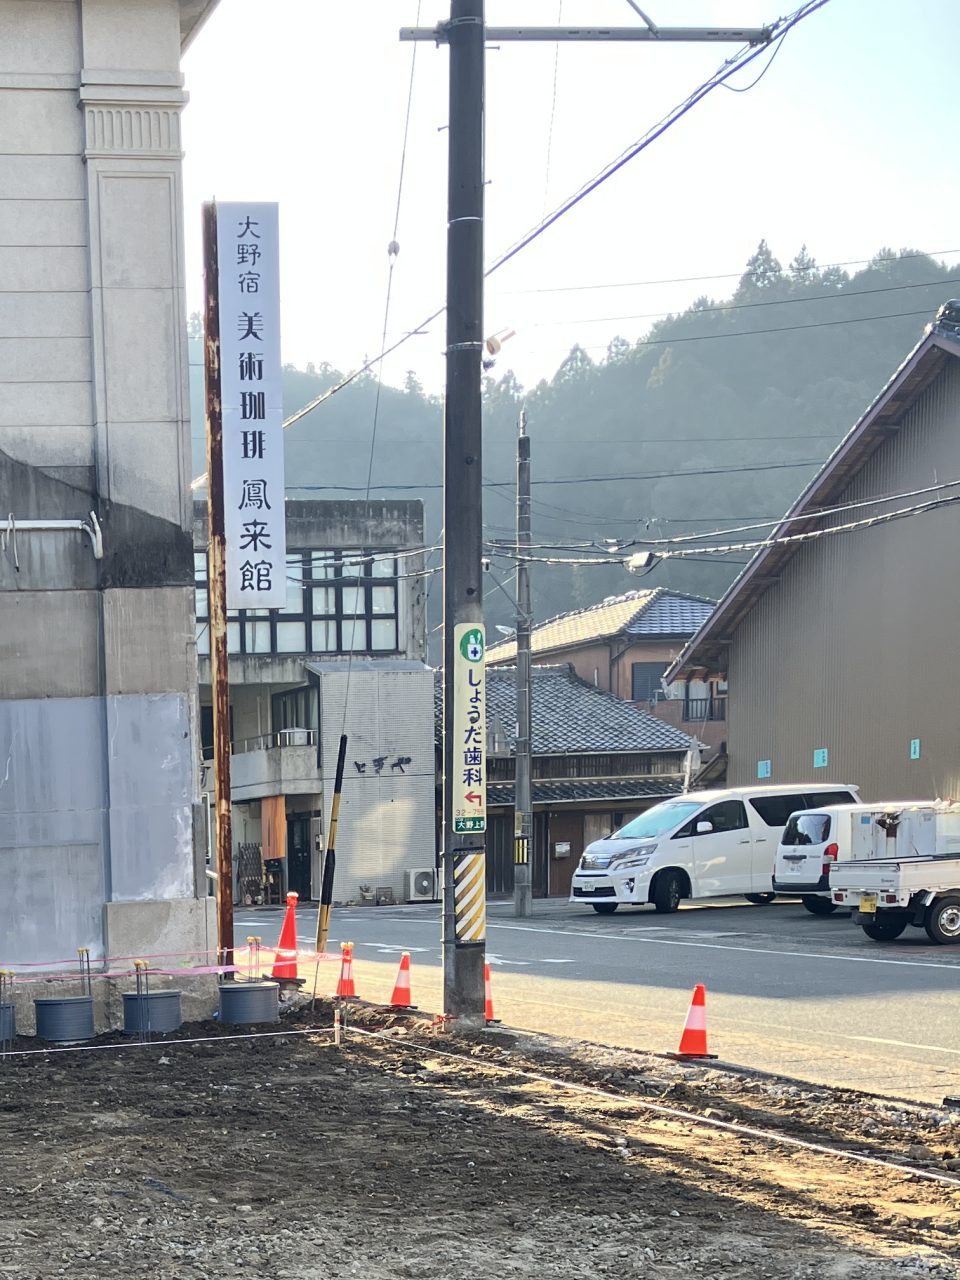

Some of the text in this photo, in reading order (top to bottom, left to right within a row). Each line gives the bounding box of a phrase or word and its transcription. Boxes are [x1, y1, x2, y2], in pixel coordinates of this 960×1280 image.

[237, 215, 273, 592] 大野宿 美術珈琲 鳳来館
[462, 669, 483, 788] しょうだ歯科
